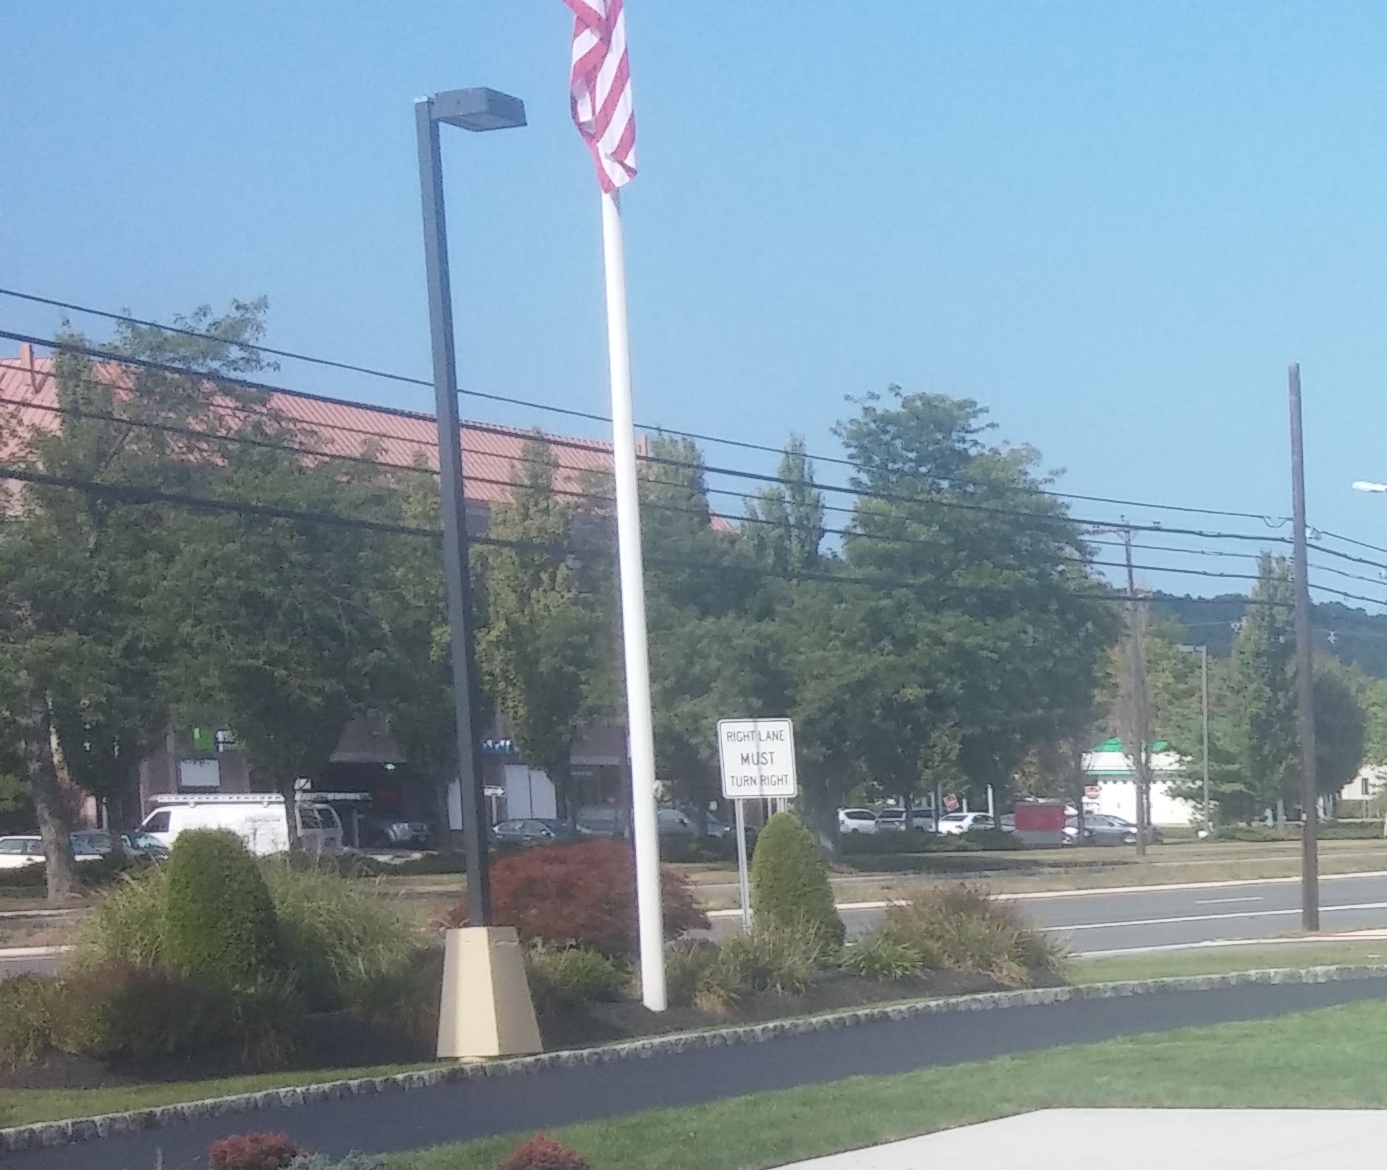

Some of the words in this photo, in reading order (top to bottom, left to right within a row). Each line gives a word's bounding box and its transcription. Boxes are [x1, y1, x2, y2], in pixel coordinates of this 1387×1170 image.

[726, 730, 756, 742] RIGHT
[759, 729, 785, 742] LANE
[740, 751, 775, 766] MUST
[730, 775, 757, 787] TURN
[760, 774, 788, 787] RIGHT
